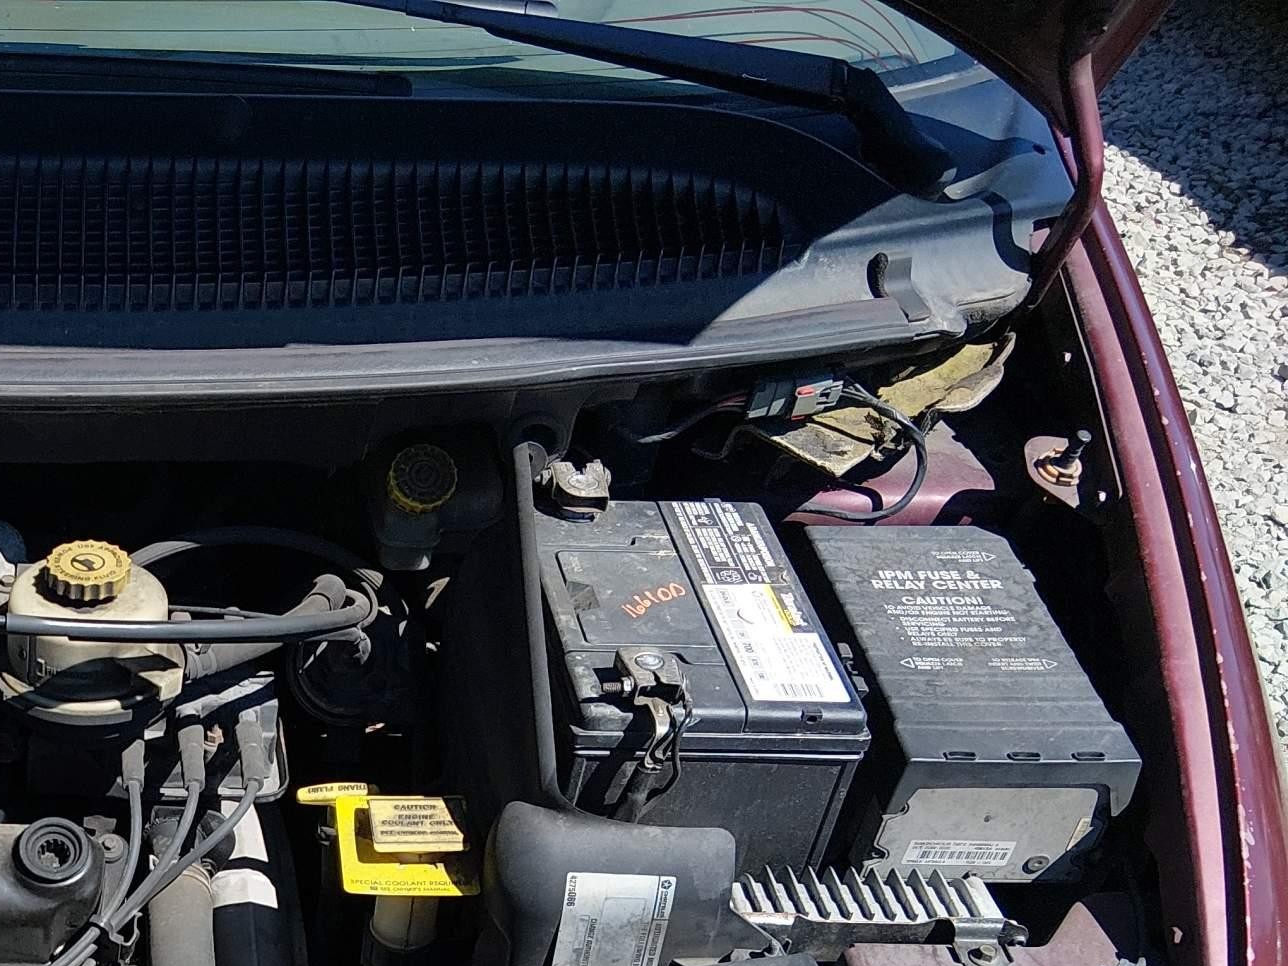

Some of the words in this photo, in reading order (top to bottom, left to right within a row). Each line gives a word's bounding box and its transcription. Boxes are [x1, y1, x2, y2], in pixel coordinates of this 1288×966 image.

[879, 570, 915, 580] IPM
[917, 570, 962, 580] FUSE
[966, 570, 980, 580] &
[871, 580, 925, 590] RELAY
[931, 580, 1004, 590] CENTER
[902, 596, 984, 605] CAUTION!
